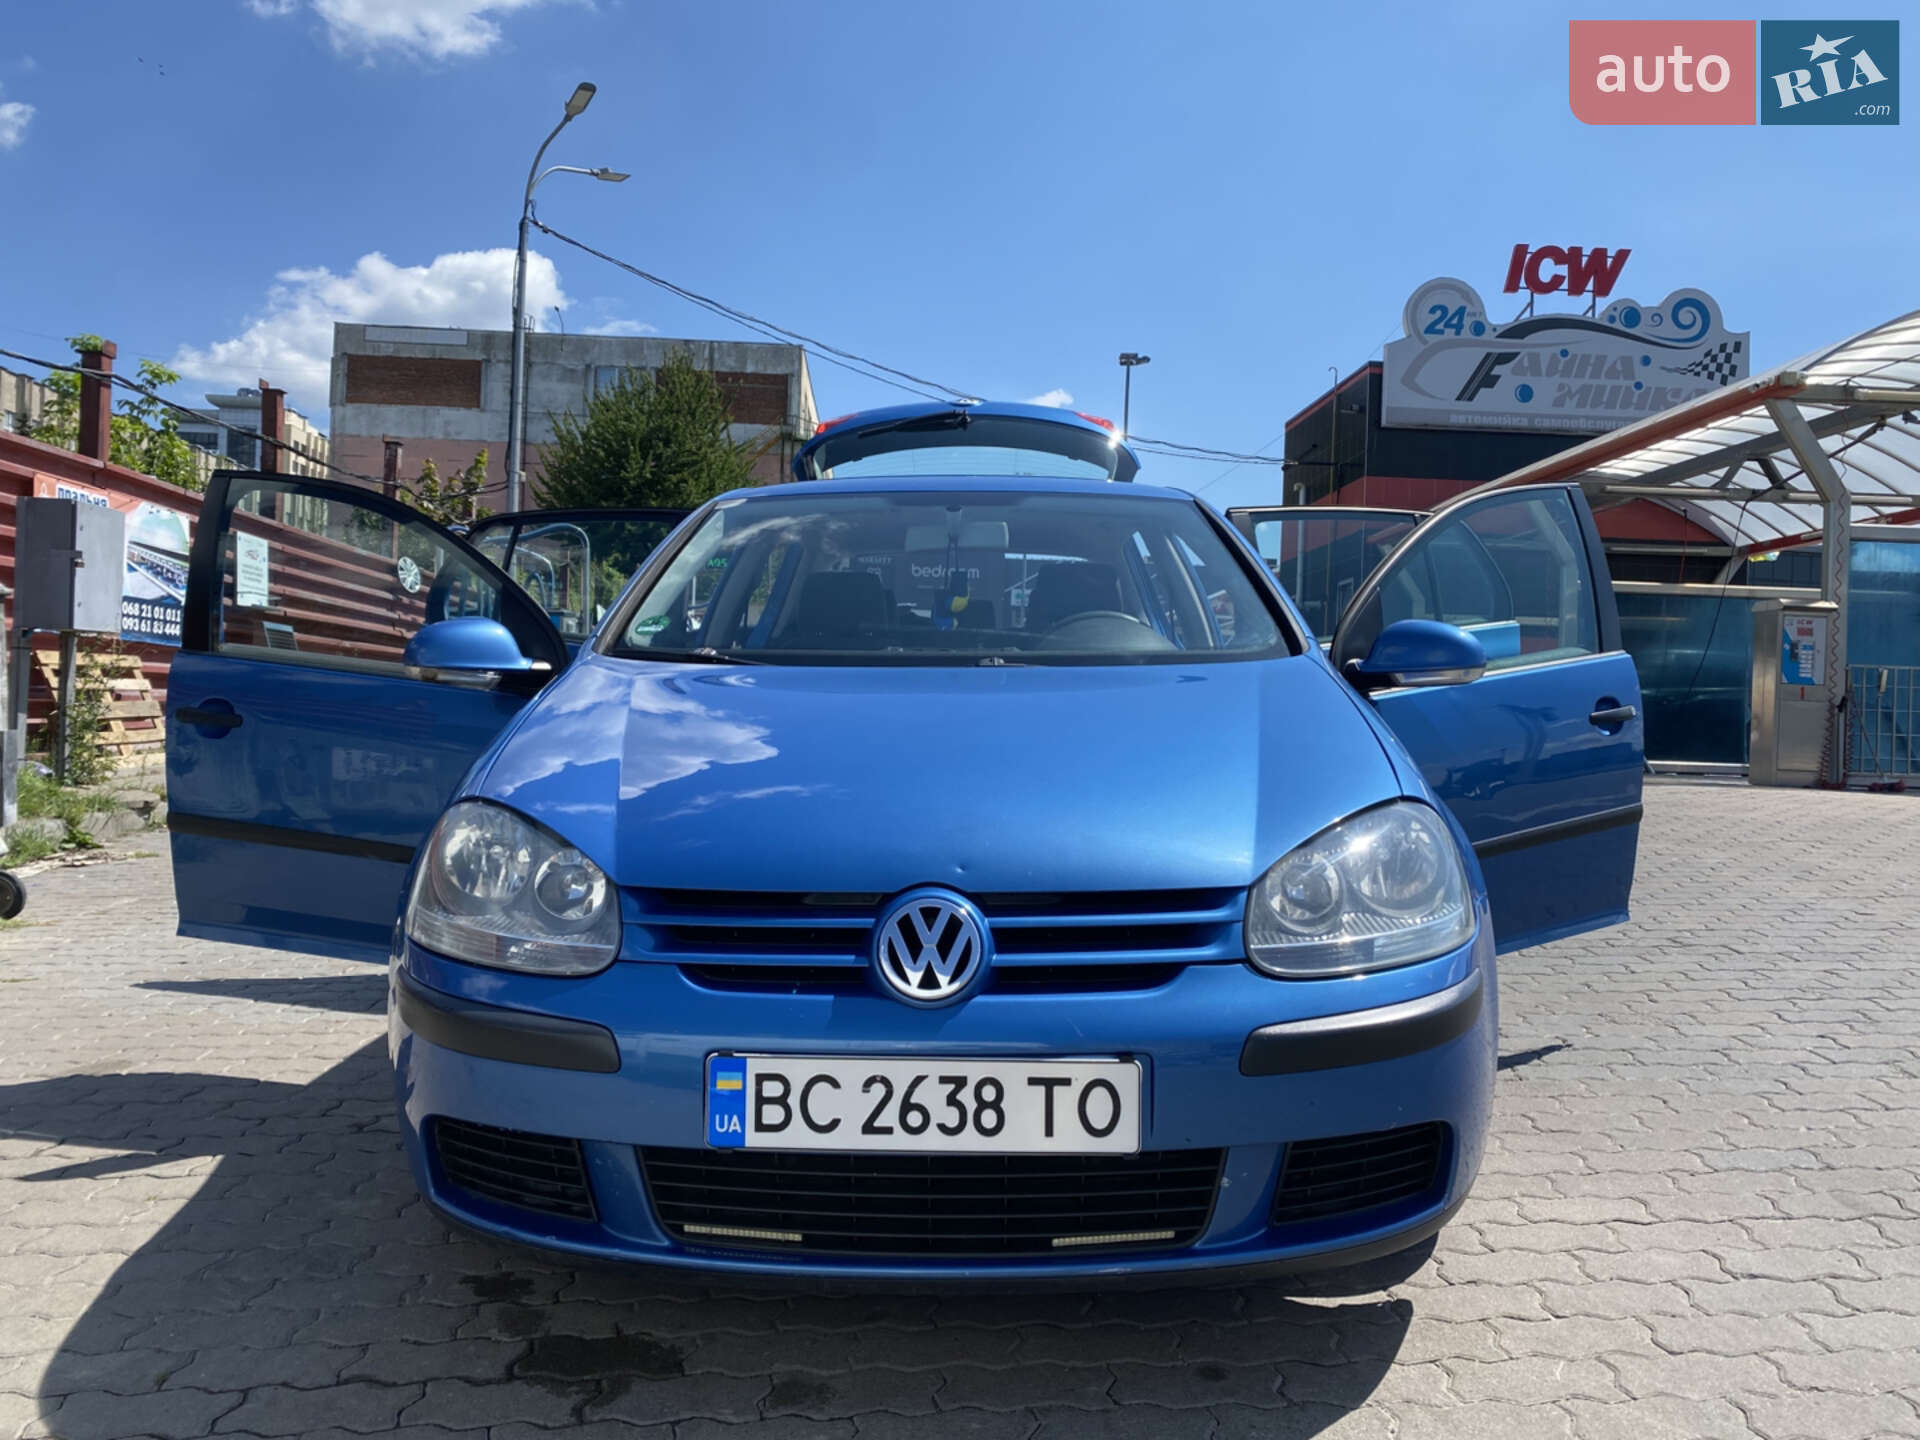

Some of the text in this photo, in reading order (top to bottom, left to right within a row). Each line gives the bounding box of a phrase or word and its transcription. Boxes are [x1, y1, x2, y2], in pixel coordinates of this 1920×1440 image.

[1503, 243, 1632, 298] ICW
[1424, 304, 1467, 336] 24
[121, 601, 181, 622] 068 21 01 011
[121, 616, 140, 632] 093
[140, 619, 151, 633] 61
[880, 898, 981, 999] VW
[753, 1073, 1121, 1138] BC 2638 TO
[715, 1113, 742, 1133] UA
